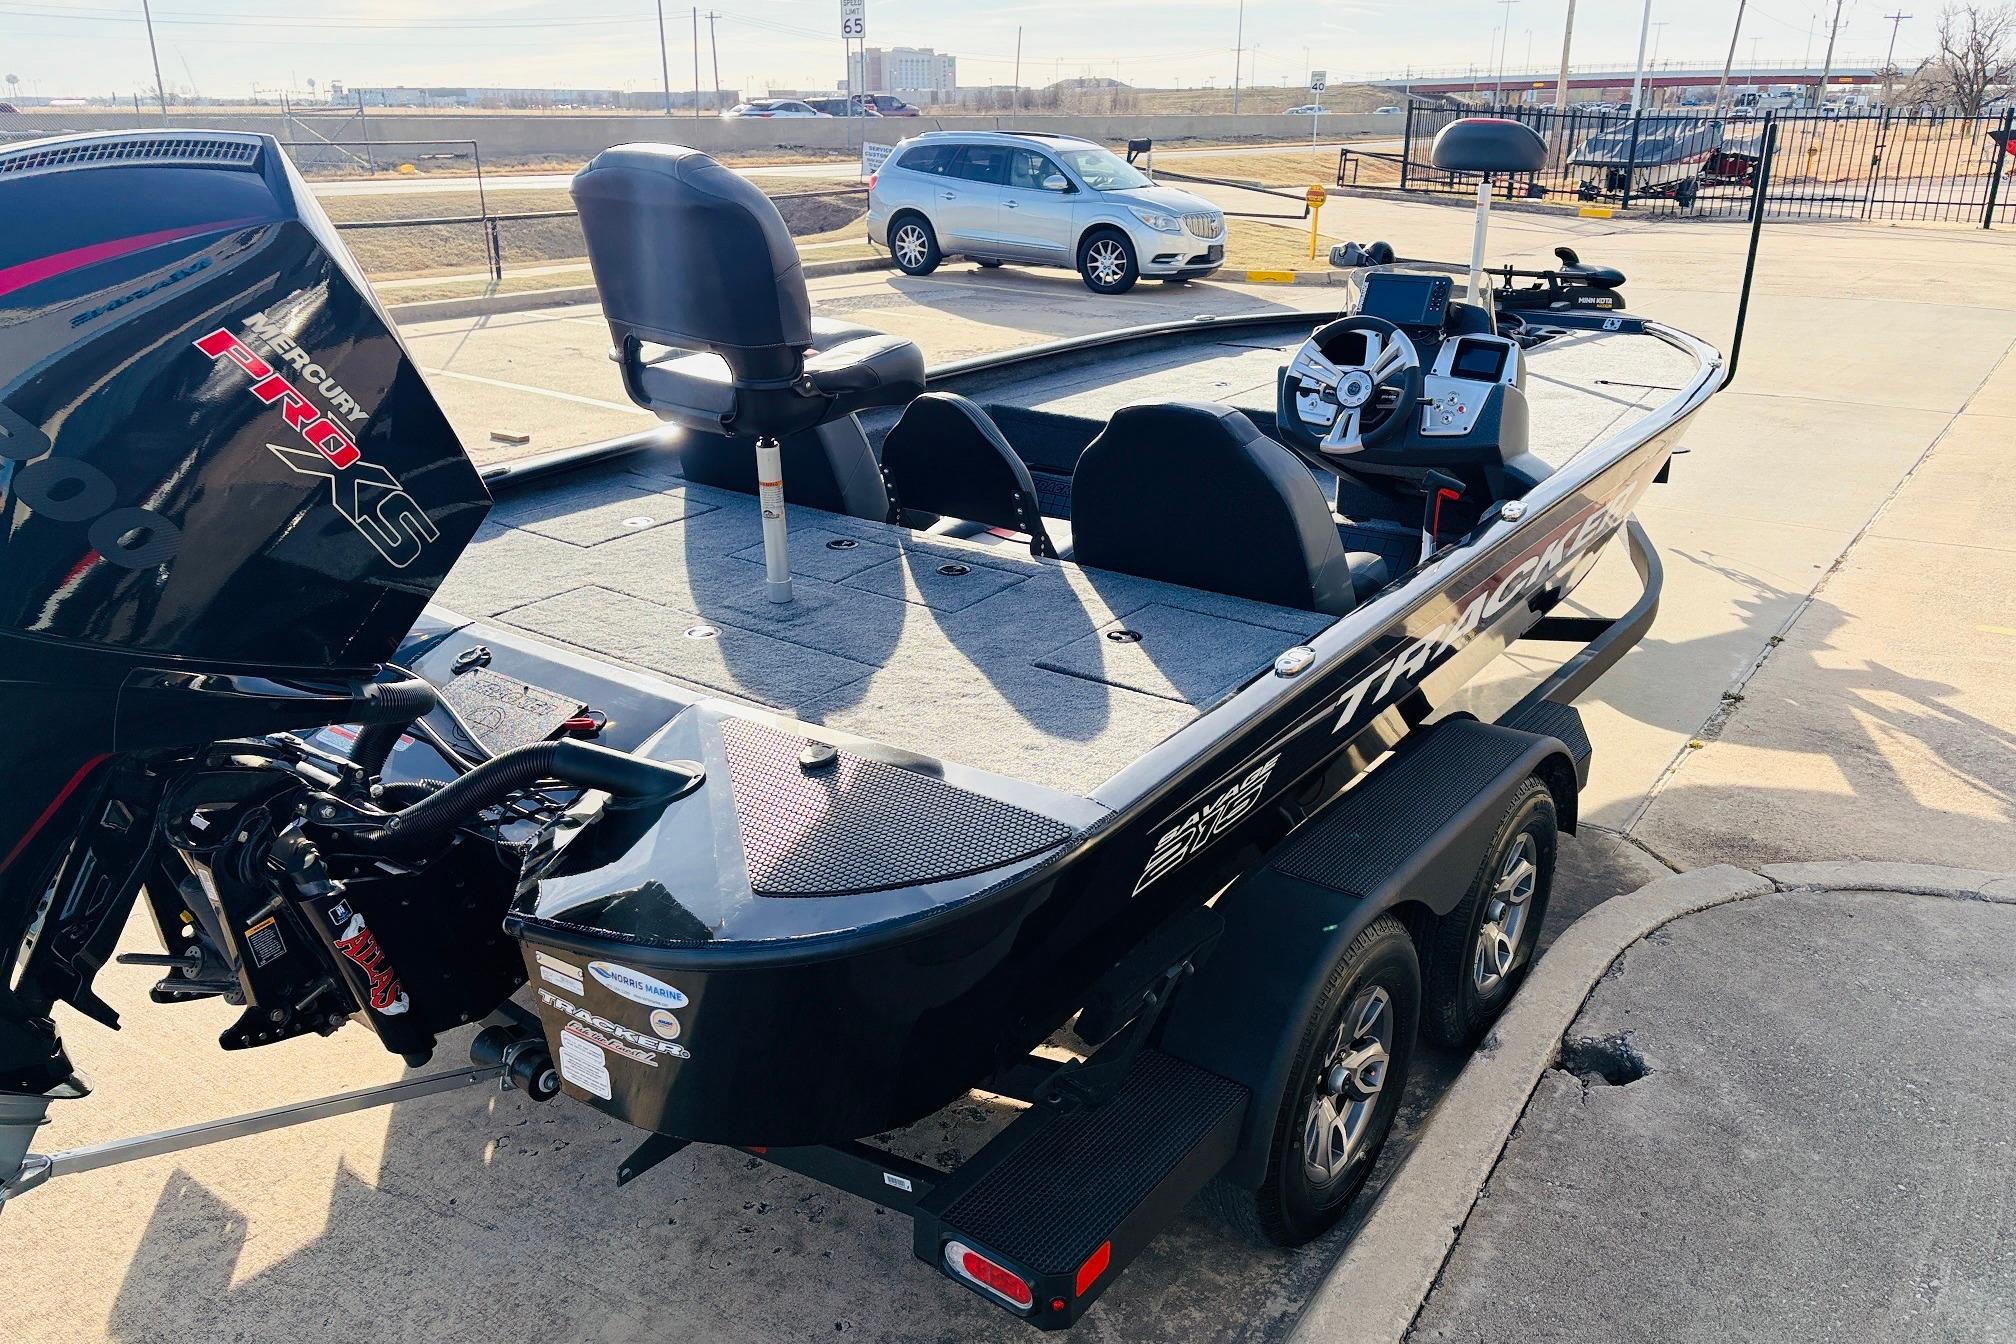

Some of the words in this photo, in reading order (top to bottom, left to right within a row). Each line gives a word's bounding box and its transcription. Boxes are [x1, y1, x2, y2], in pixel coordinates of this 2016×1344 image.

[843, 18, 863, 34] 65
[1311, 82, 1325, 91] 40
[193, 327, 361, 470] PRO
[242, 312, 369, 422] MERCURY
[266, 411, 440, 568] XS
[1331, 480, 1637, 734] TRACKER
[1131, 769, 1273, 898] 215
[1154, 752, 1282, 851] SAVAGE
[334, 927, 402, 1009] ATLAS
[611, 971, 643, 991] NORRIS
[645, 984, 683, 1001] MARINE
